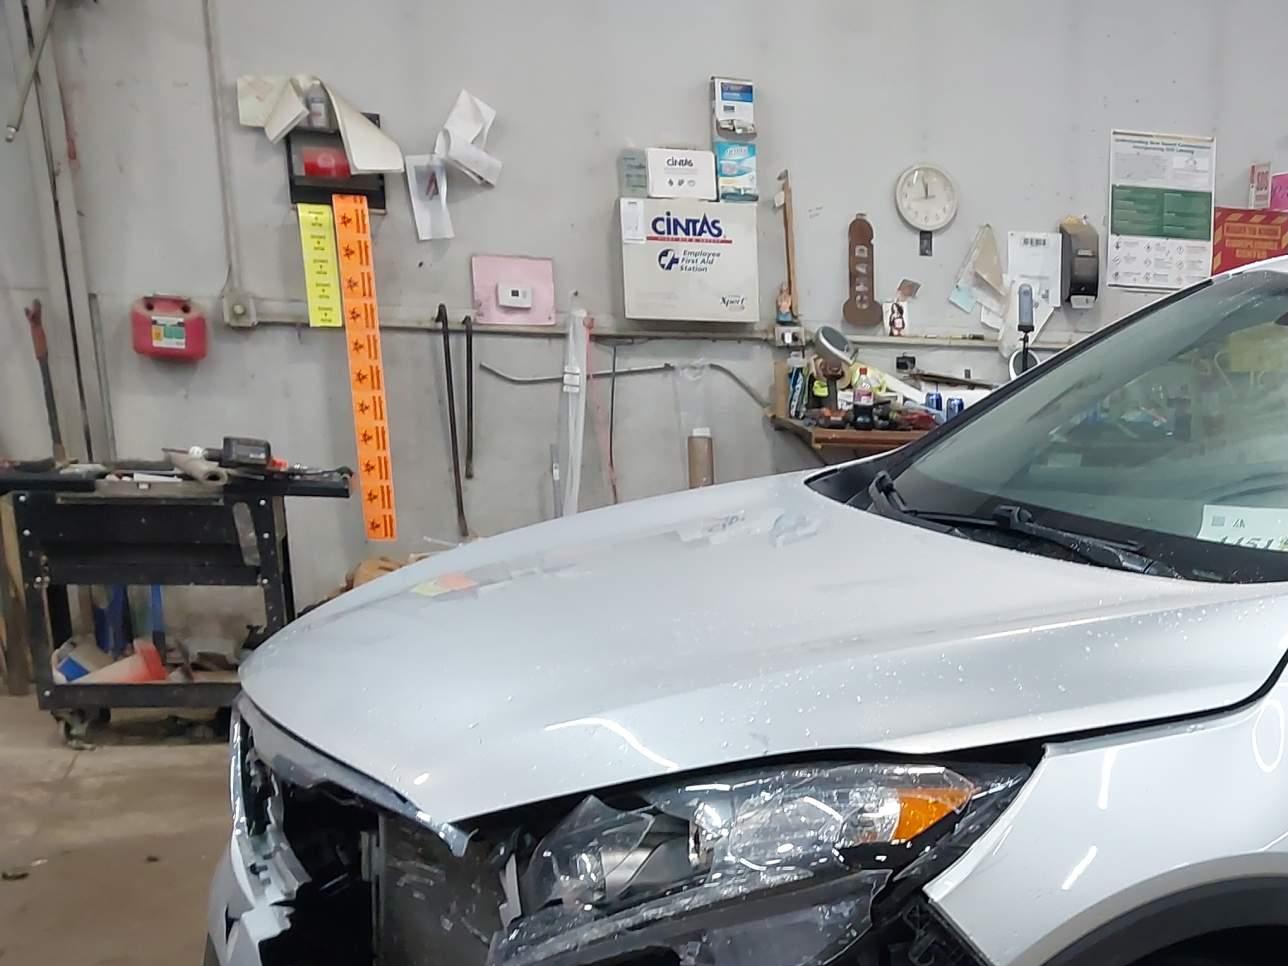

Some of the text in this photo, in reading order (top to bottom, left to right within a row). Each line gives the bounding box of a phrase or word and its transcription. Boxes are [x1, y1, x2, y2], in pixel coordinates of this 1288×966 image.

[682, 249, 721, 258] Employee
[700, 257, 715, 265] Aid
[680, 264, 708, 272] Station
